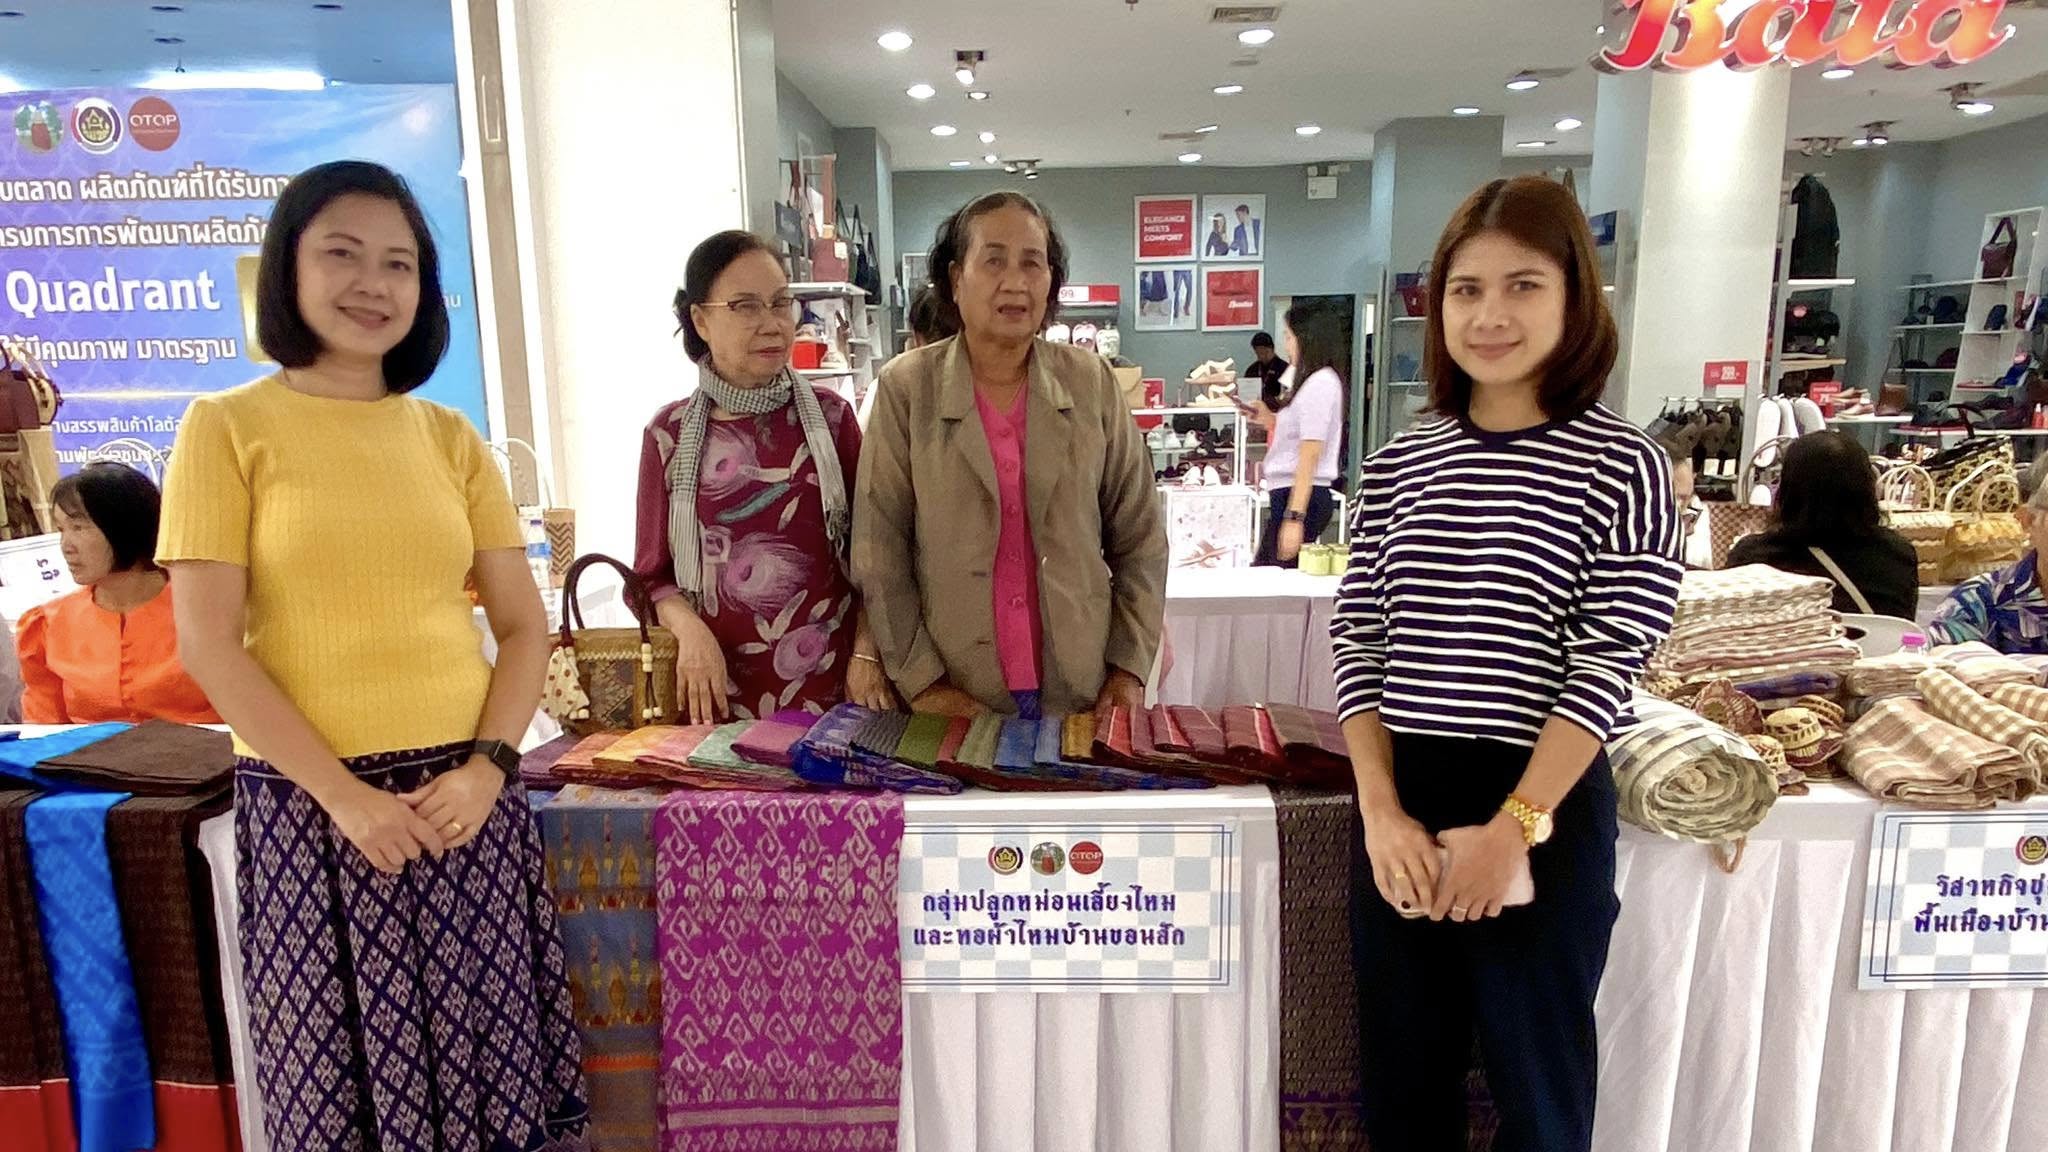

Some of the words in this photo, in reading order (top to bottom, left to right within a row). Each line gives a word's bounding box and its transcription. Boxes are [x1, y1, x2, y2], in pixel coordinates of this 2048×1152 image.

[129, 114, 177, 127] OTOP
[6, 266, 220, 319] Quadrant
[136, 337, 237, 365] มาตรฐาน
[1070, 851, 1102, 860] OTOP
[923, 882, 1176, 920] กลุ่มปลูกหม่อนเลี้ยงไหม
[1937, 873, 2048, 905] วิสาหกิจชุ
